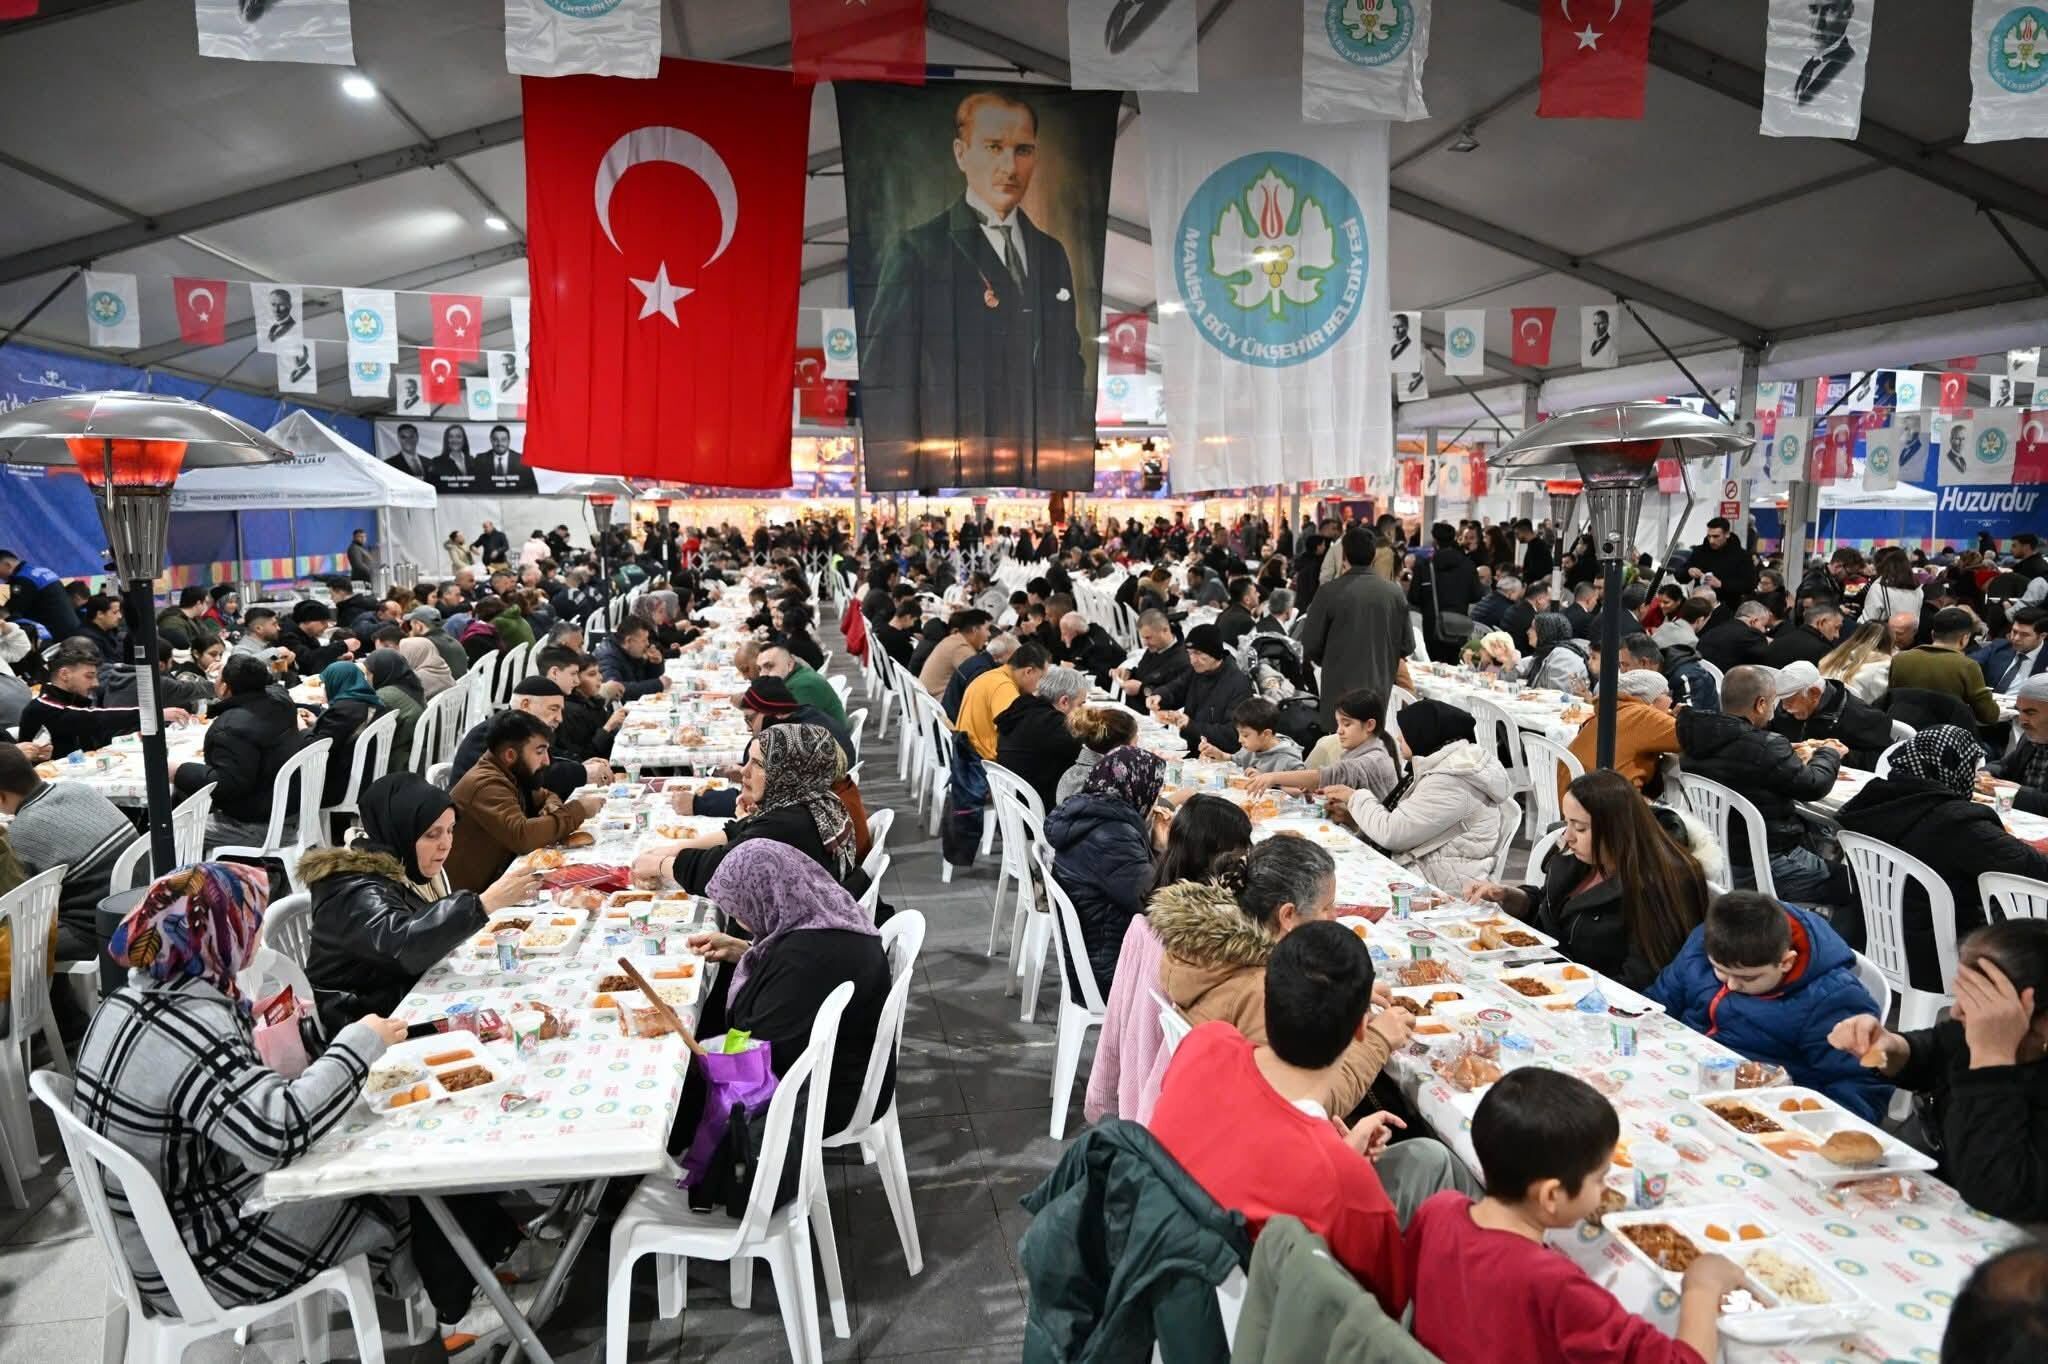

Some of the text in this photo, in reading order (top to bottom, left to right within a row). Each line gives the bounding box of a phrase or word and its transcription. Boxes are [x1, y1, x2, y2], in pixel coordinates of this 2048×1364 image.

[1183, 216, 1363, 365] MANİSA BÜYÜKŞEHİR BELEDİYESİ
[1938, 486, 2040, 513] Huzurdur
